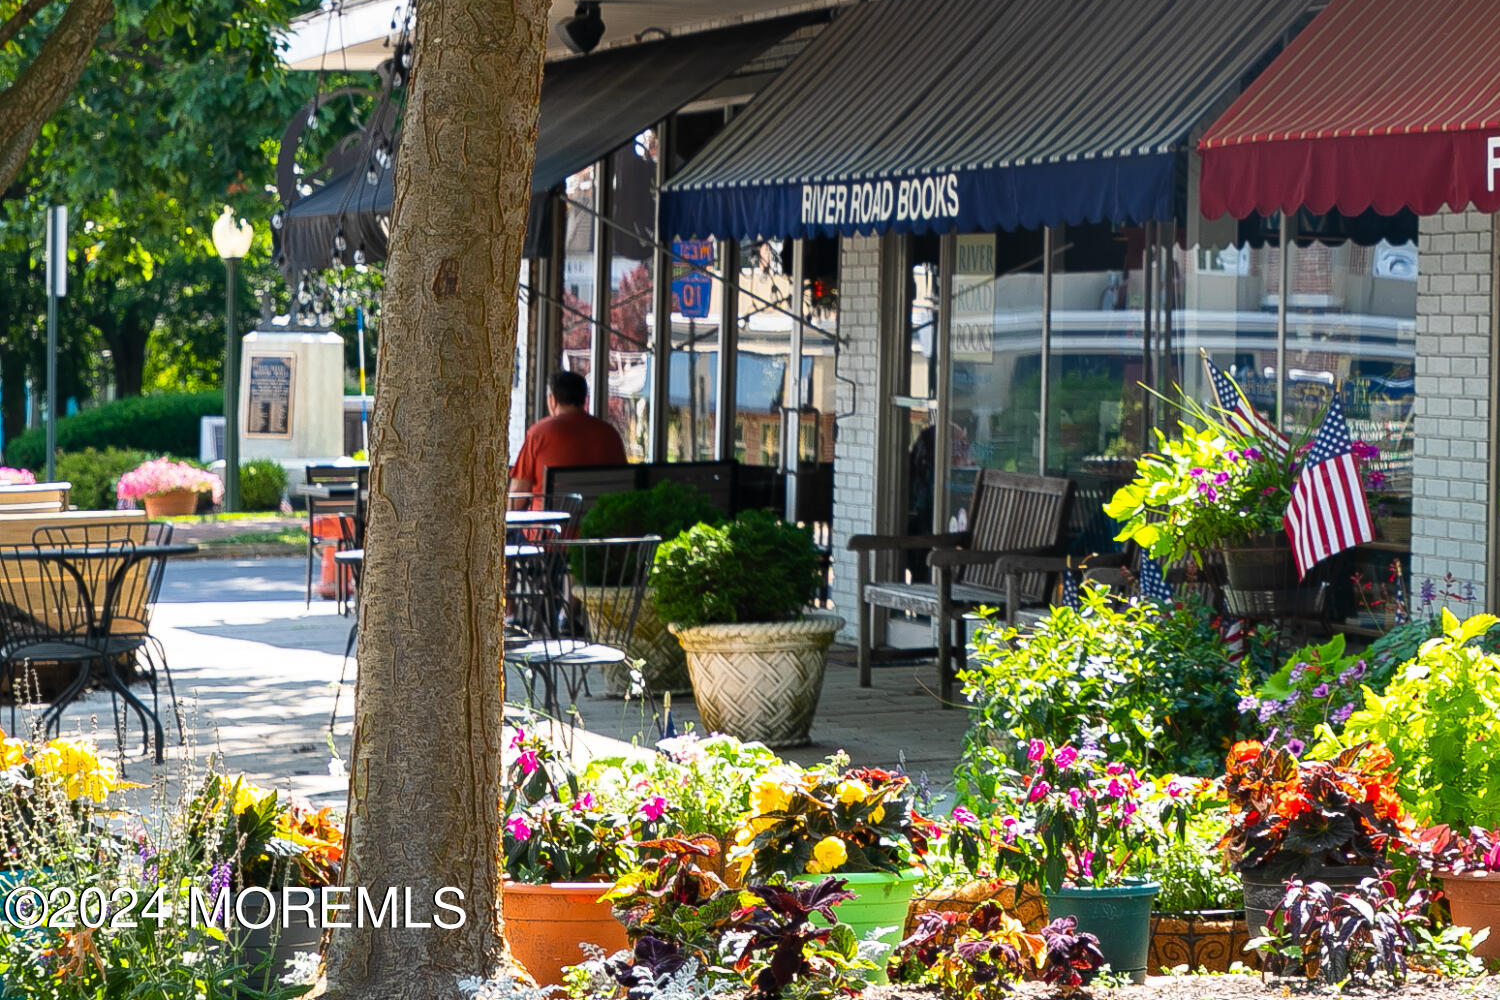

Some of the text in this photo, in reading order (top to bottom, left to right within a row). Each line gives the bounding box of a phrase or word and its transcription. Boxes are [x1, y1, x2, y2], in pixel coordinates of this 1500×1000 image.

[802, 173, 960, 225] RIVER ROAD BOOKS
[958, 245, 993, 272] RIVER
[956, 283, 993, 313] ROAD
[955, 323, 993, 351] BOOKS
